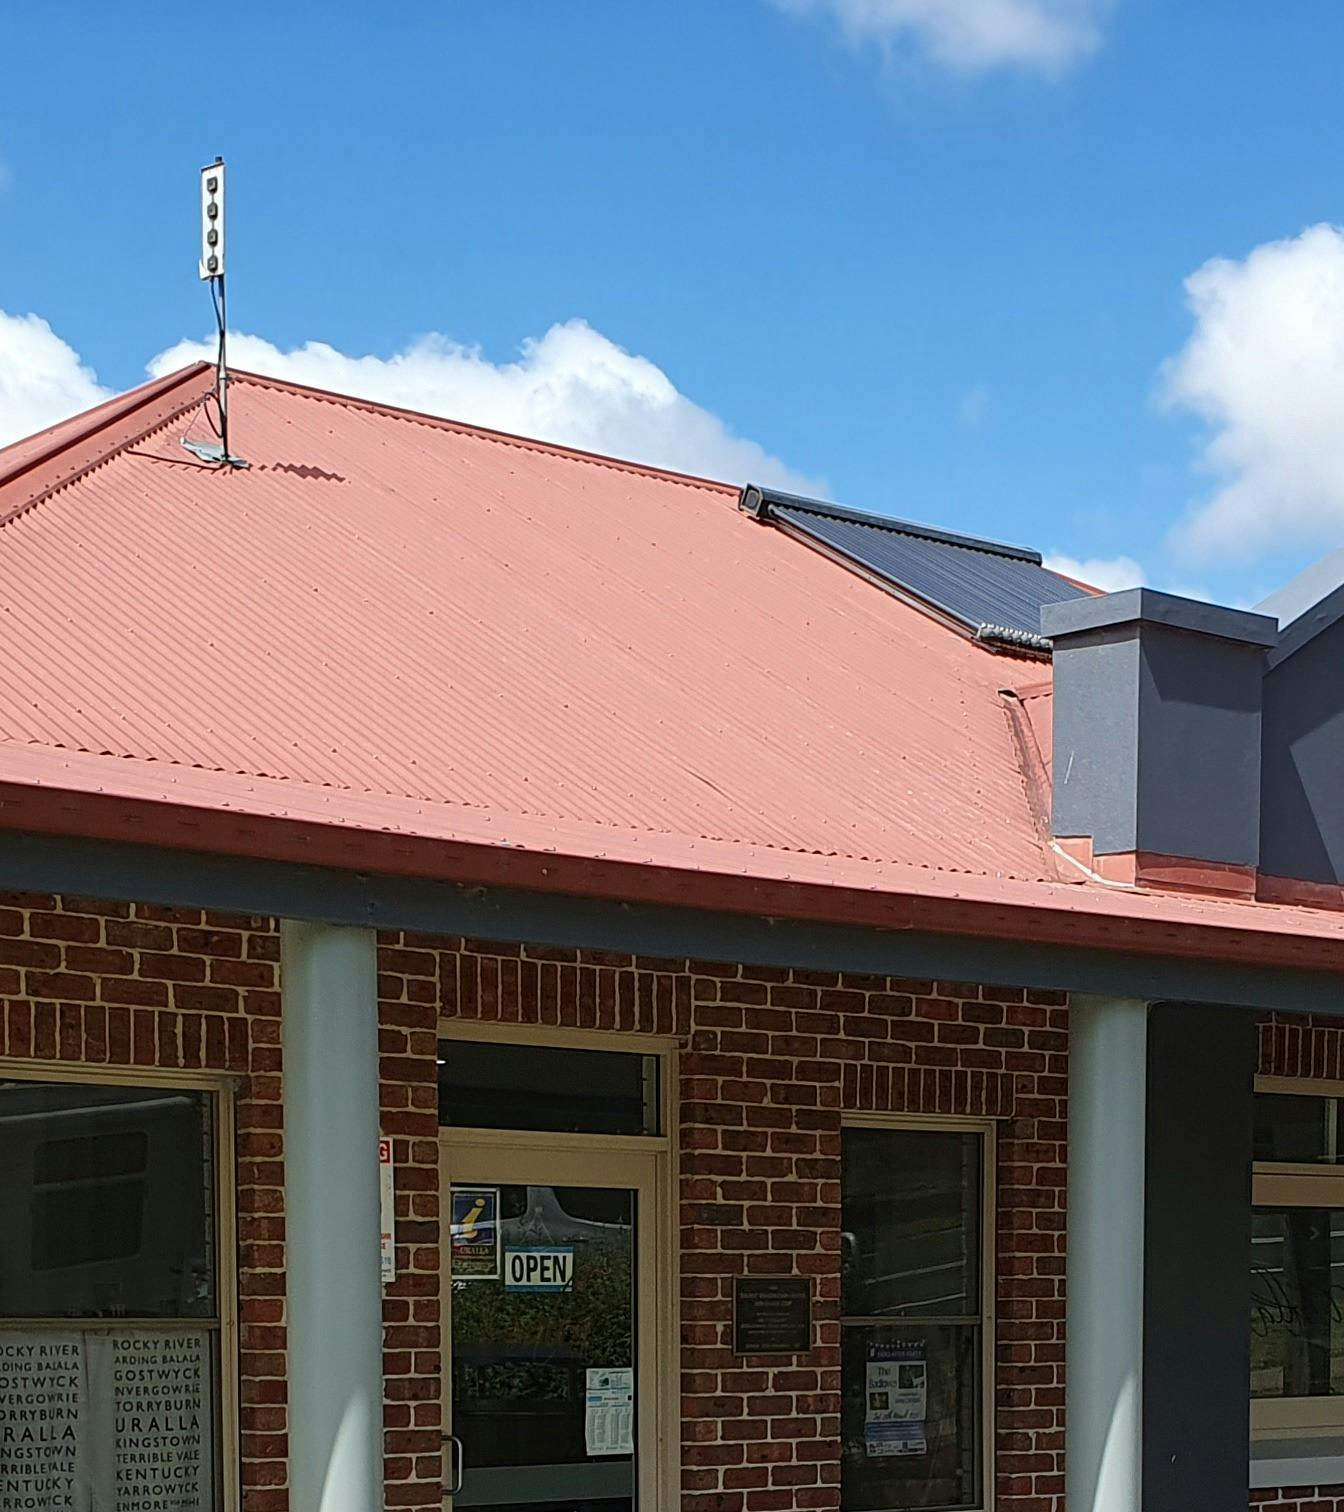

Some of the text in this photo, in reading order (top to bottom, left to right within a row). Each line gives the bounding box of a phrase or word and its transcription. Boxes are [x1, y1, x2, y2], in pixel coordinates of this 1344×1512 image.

[511, 1254, 567, 1283] OPEN
[40, 1344, 79, 1357] RIVER
[113, 1337, 201, 1351] ROCKY RIVER
[37, 1361, 80, 1372] BALALA
[114, 1354, 201, 1365] ARDING BALALA
[114, 1367, 201, 1381] GOSTWYCK
[114, 1383, 201, 1397] NVERGOWRIE
[115, 1398, 201, 1412] TORRYBURN
[115, 1414, 200, 1433] URALLA
[116, 1434, 201, 1448] KINGSTOWN
[116, 1449, 200, 1464] TERRIBLE VALE
[116, 1464, 200, 1481] KENTUCKY
[117, 1481, 199, 1497] YARROWYCK
[116, 1500, 168, 1512] ENMORE
